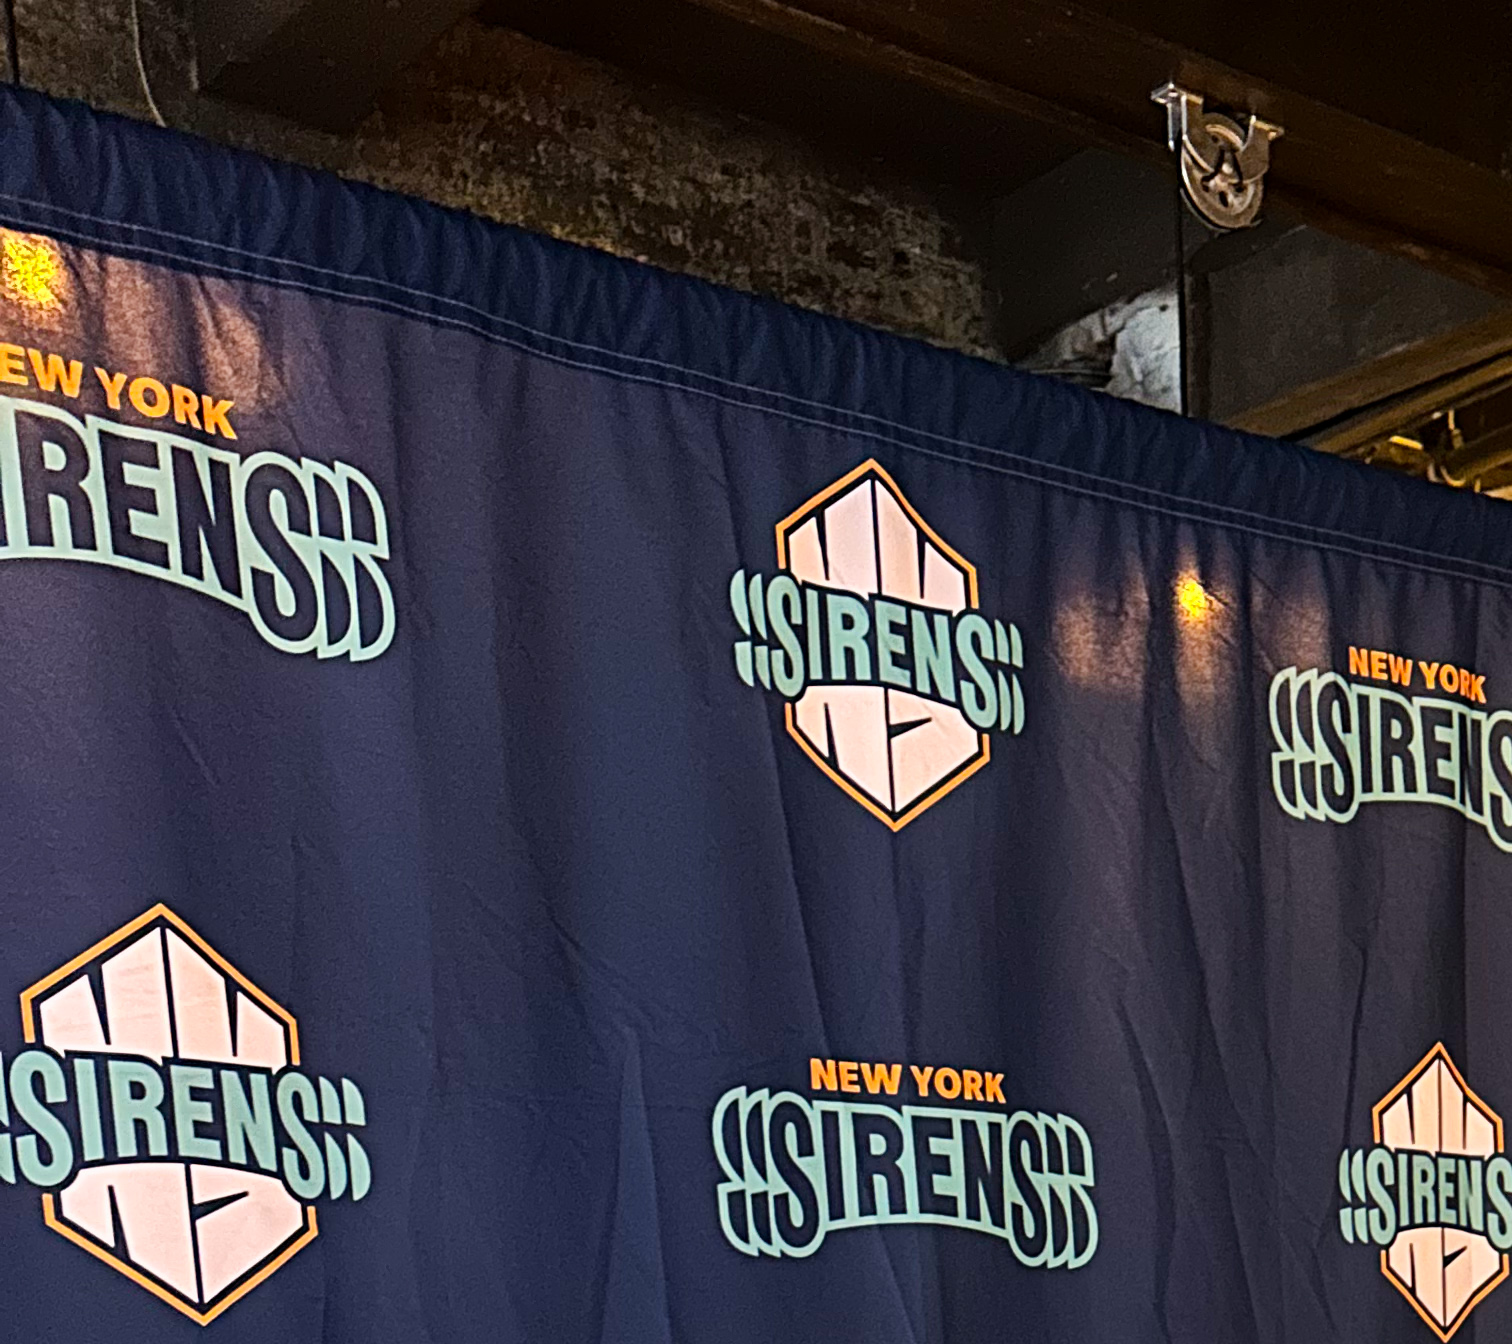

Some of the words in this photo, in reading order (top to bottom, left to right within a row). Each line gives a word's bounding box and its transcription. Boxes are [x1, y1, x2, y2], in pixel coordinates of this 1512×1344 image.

[0, 342, 82, 398] EW
[94, 367, 237, 439] YORK
[0, 394, 395, 661] RENS
[760, 573, 1001, 730] SIRENS
[1349, 646, 1412, 686] NEW
[1418, 661, 1486, 704] YORK
[8, 1050, 328, 1200] SIRENS
[809, 1058, 901, 1095] NEW
[909, 1065, 1006, 1104] YORK
[712, 1086, 1099, 1269] SIRENS
